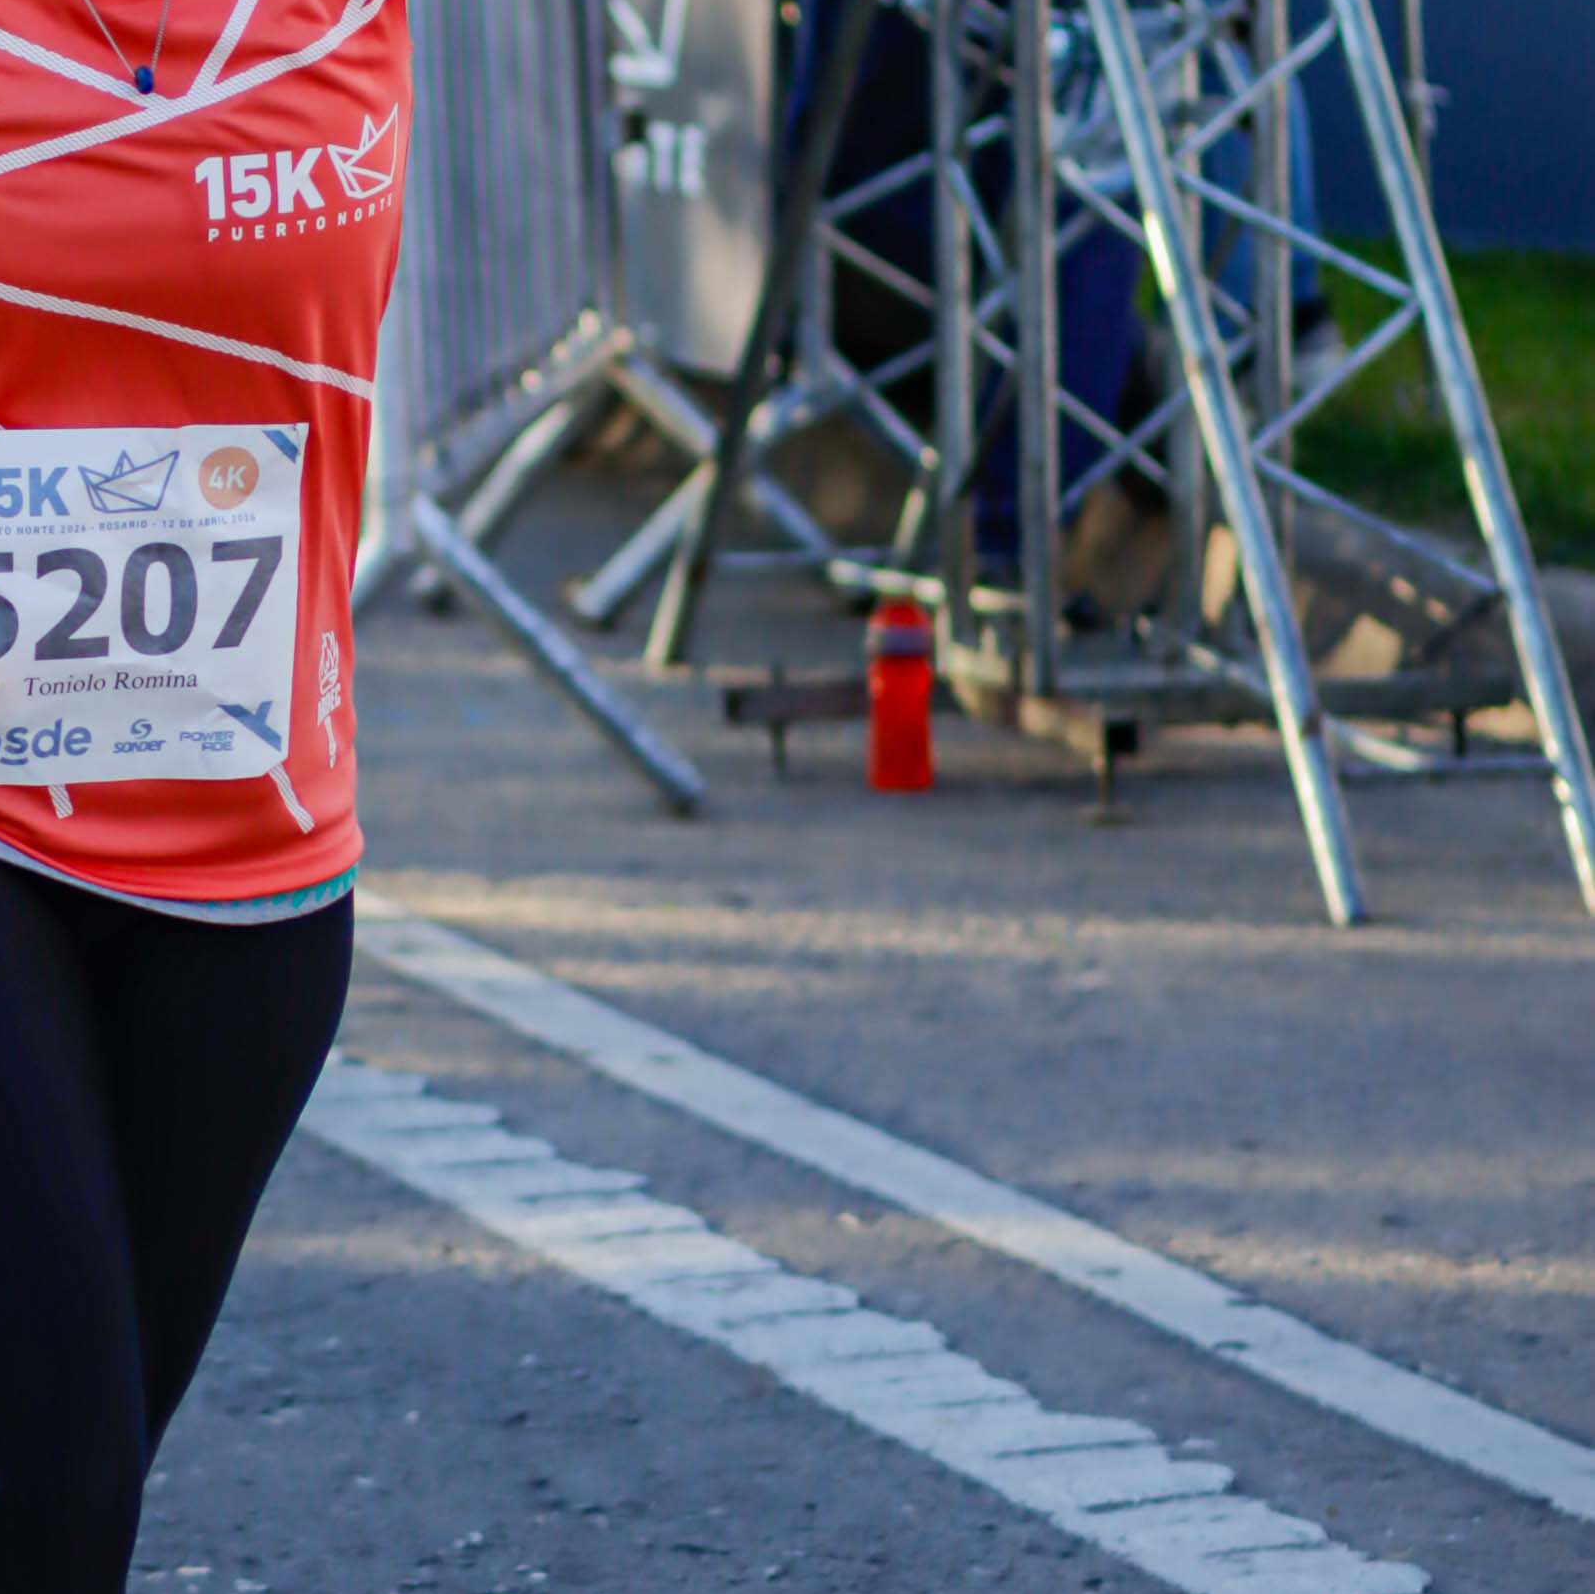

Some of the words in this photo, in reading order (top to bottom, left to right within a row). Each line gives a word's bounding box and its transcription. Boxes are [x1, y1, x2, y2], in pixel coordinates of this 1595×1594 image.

[194, 147, 325, 220] 15K
[207, 216, 326, 242] PUERTO
[337, 193, 393, 226] NORTE
[208, 464, 246, 491] 4K
[16, 524, 55, 535] NORTE
[99, 520, 148, 531] ROSARIO
[162, 519, 175, 529] 12
[179, 518, 193, 529] DE
[198, 516, 227, 527] ABRIL
[23, 673, 107, 697] Toniolo
[113, 669, 199, 692] Romina
